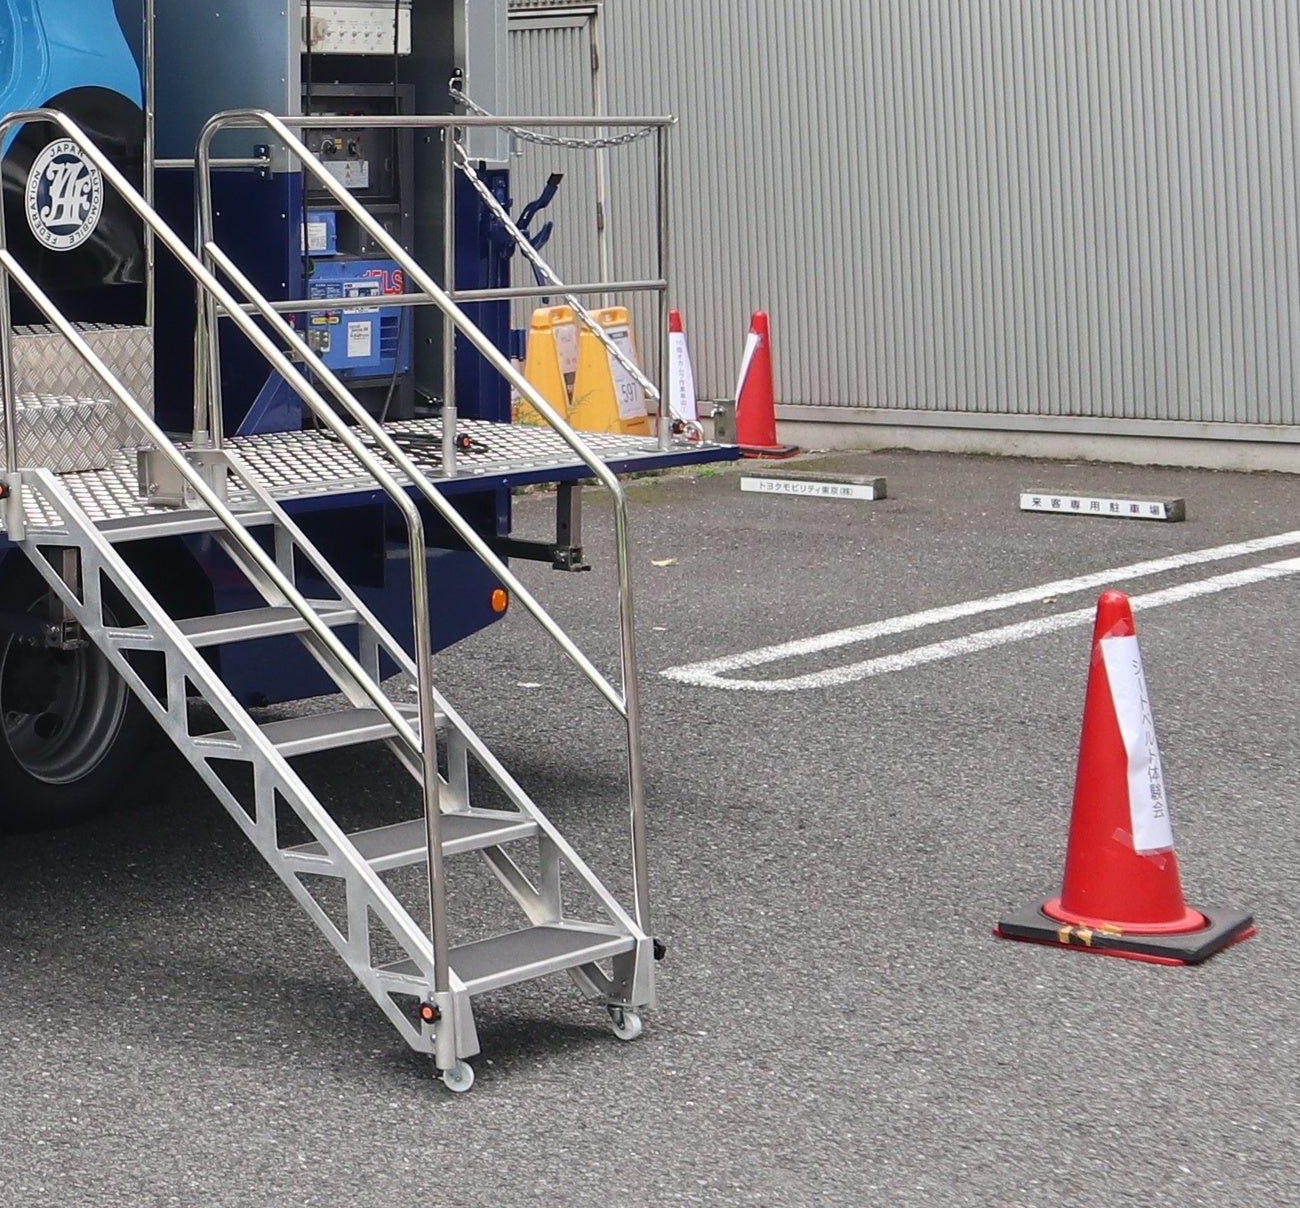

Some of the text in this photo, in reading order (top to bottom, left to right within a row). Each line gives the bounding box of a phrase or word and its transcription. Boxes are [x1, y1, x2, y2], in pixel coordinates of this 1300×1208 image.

[29, 170, 58, 245] FEDERATION
[69, 168, 100, 244] AUTOMOBILE
[1031, 497, 1160, 516] 来客専用駐車場
[1131, 659, 1166, 820] シートベルト体験会
